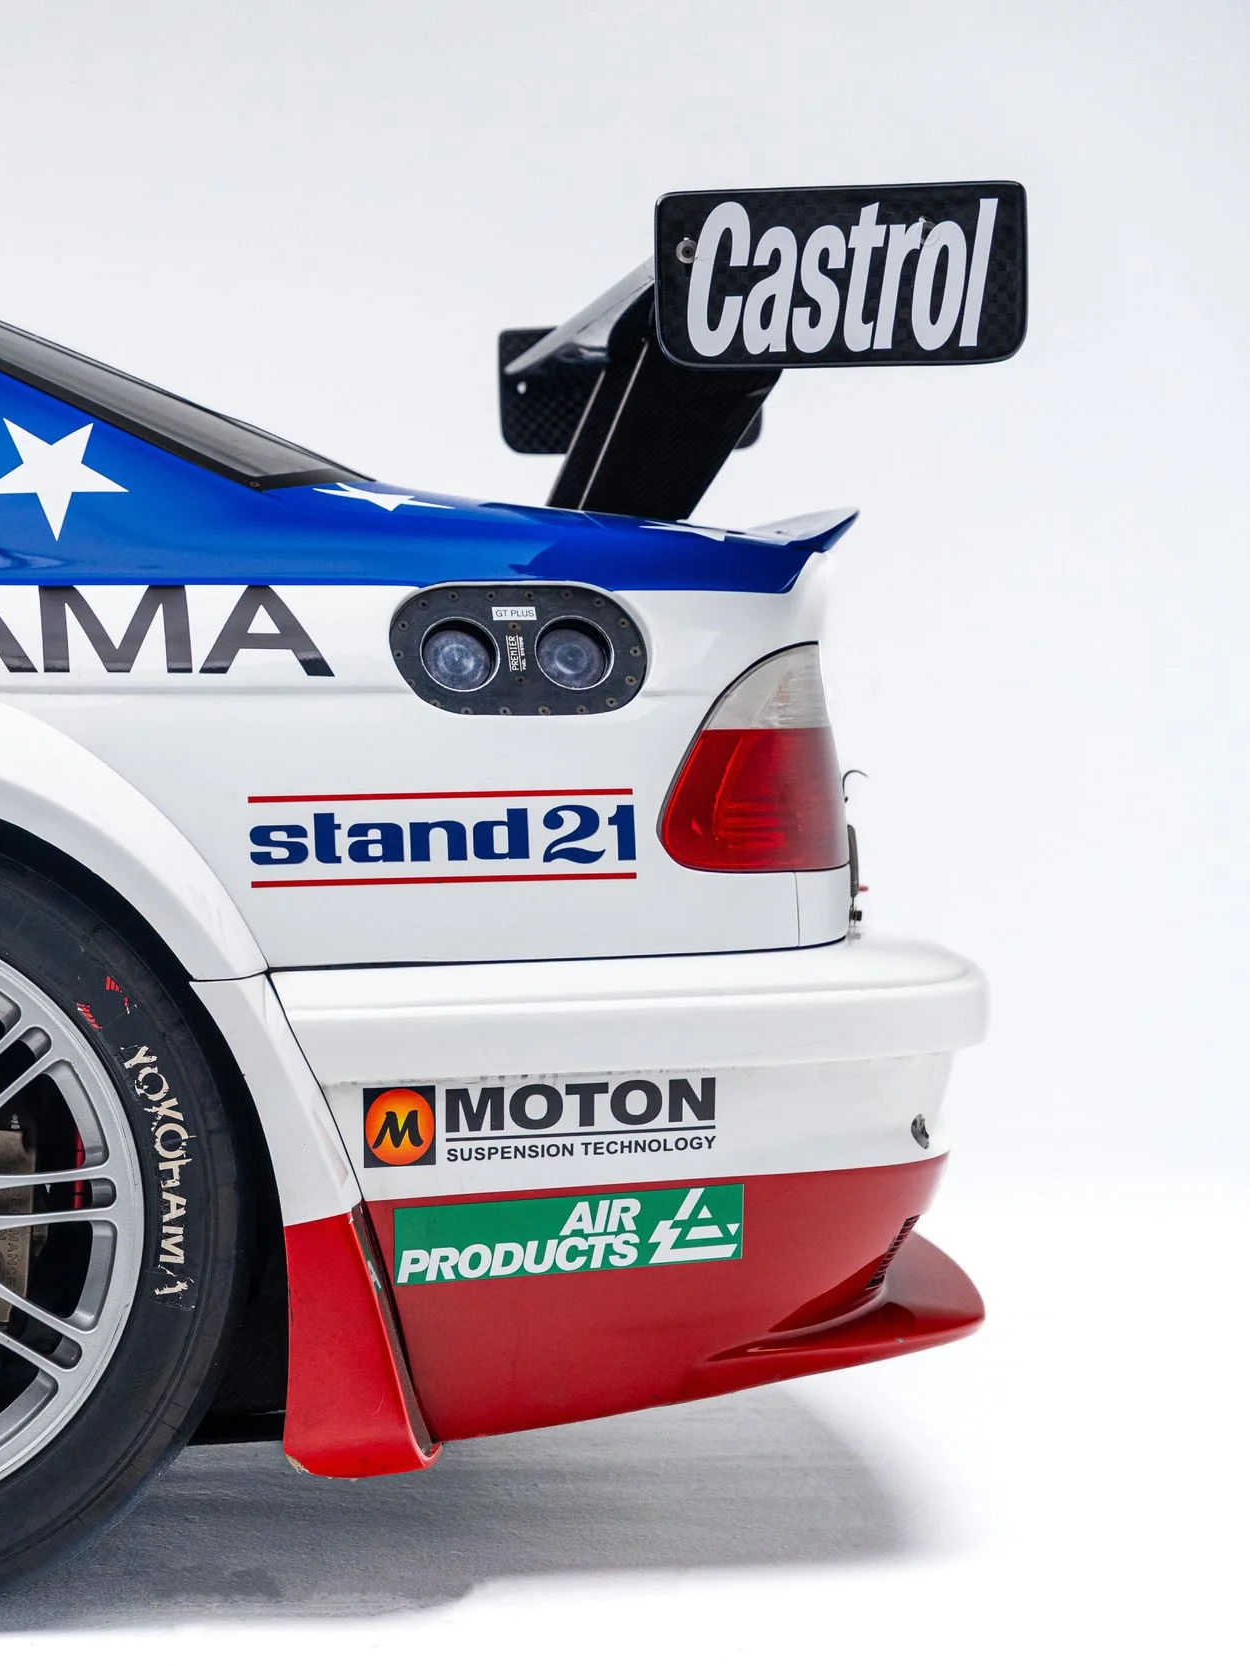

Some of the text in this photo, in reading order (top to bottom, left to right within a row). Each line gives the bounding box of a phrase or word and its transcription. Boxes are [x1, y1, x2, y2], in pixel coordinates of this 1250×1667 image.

[687, 198, 999, 357] Castrol
[509, 636, 520, 671] PREMIER
[445, 1077, 716, 1132] MOTON
[446, 1135, 716, 1162] SUSPENSION TECHNOLOGY
[559, 1198, 641, 1236] AIR
[396, 1231, 638, 1284] PRODUCTS
